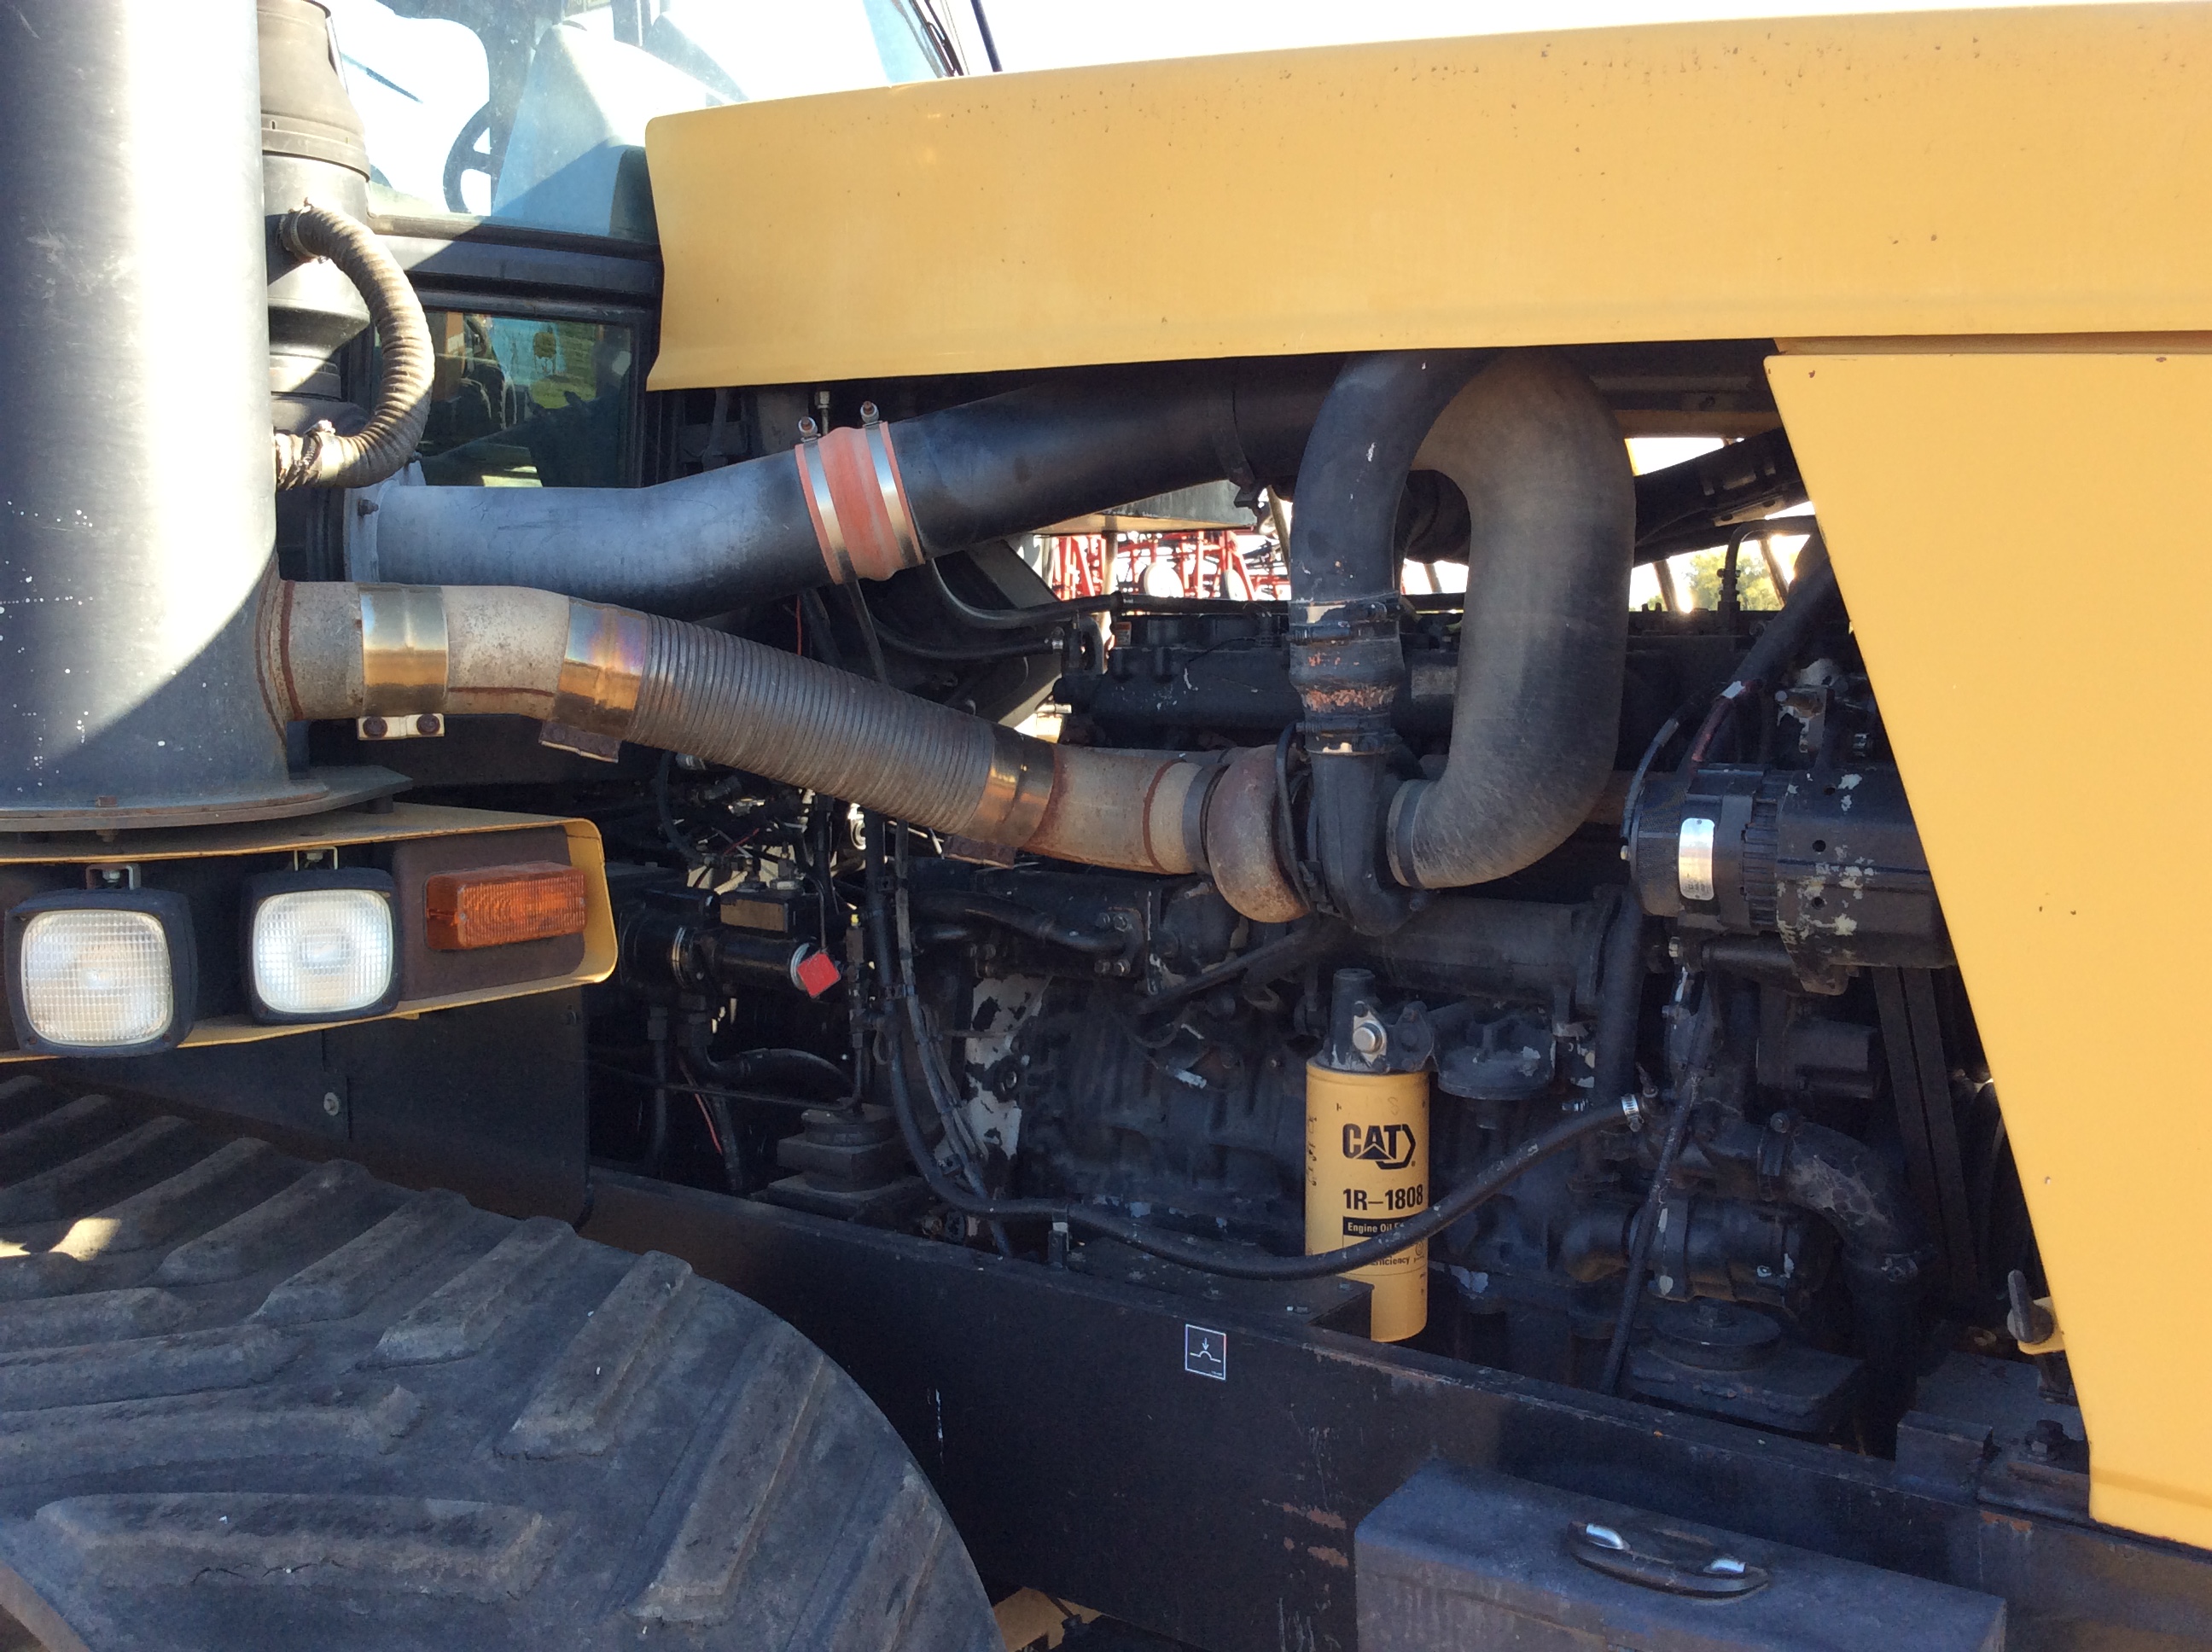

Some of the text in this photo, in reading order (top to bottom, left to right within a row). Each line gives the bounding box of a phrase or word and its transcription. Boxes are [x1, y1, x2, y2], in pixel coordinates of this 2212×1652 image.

[1342, 1123, 1399, 1160] CAT
[1342, 1184, 1423, 1211] 1R-1808
[1348, 1222, 1378, 1235] Engine
[1380, 1223, 1393, 1233] Oil
